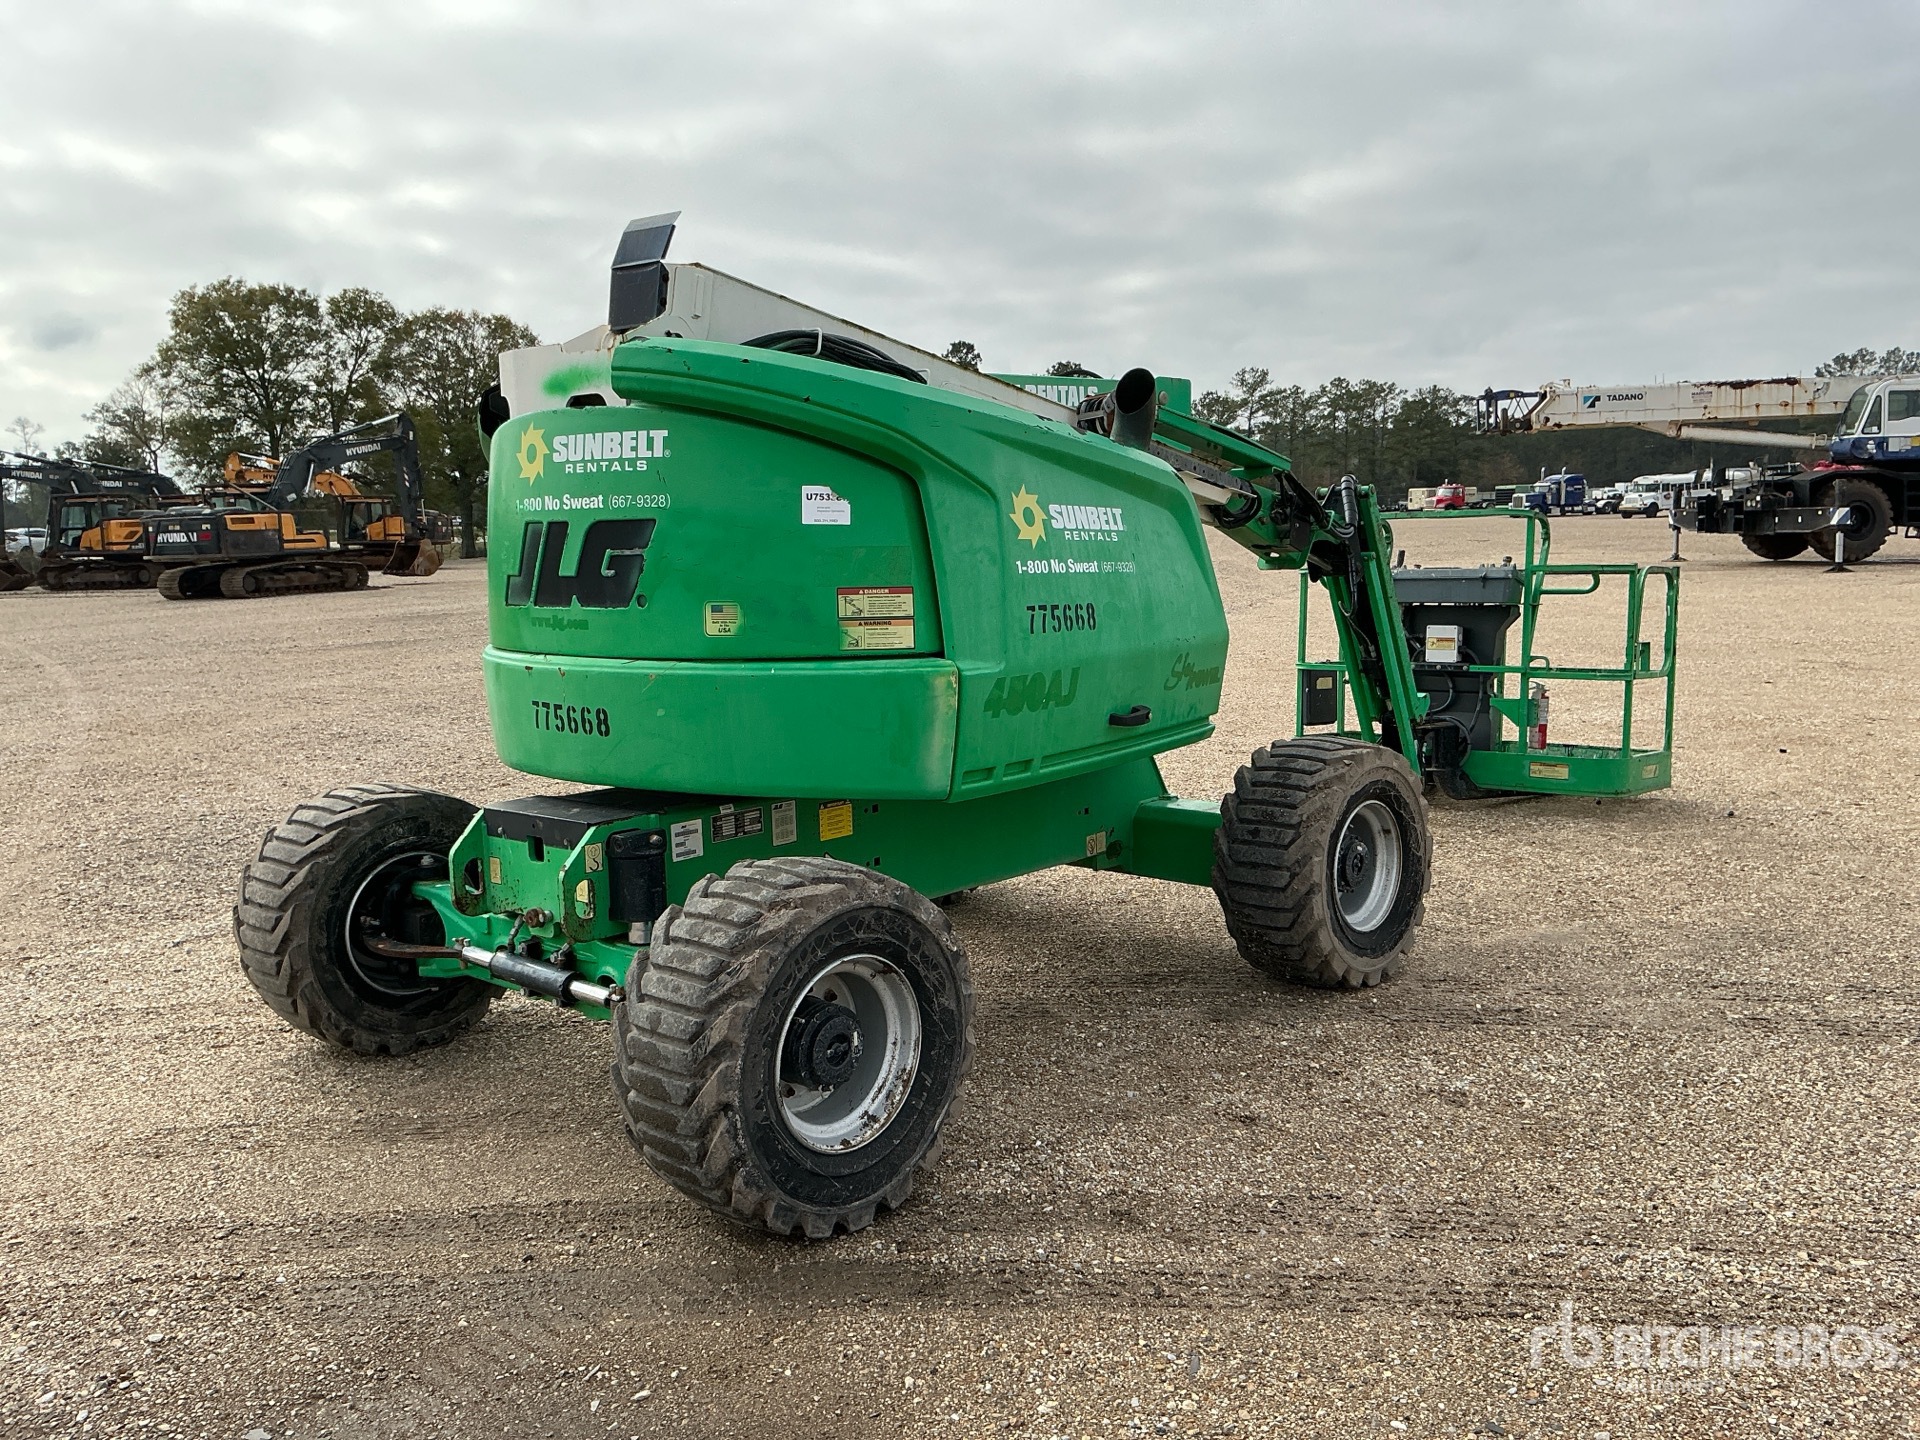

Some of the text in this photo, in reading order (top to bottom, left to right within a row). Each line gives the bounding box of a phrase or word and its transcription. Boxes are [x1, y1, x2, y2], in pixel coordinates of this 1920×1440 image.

[1606, 393, 1644, 402] TADANO
[345, 443, 382, 457] HYUNDAI
[552, 429, 669, 463] SUNBELT
[565, 460, 648, 474] RENTALS
[11, 471, 43, 480] HYUNDAI
[544, 495, 560, 511] No
[562, 493, 604, 510] Sweat
[608, 493, 671, 510] (667-9328)
[1048, 504, 1124, 531] SUNBELT
[1064, 531, 1118, 541] RENTALS
[1015, 559, 1136, 574] 1-800 No Sweat (667-9328)
[1026, 602, 1097, 635] 775668
[983, 666, 1081, 719] 450AJ
[531, 700, 611, 738] 775668
